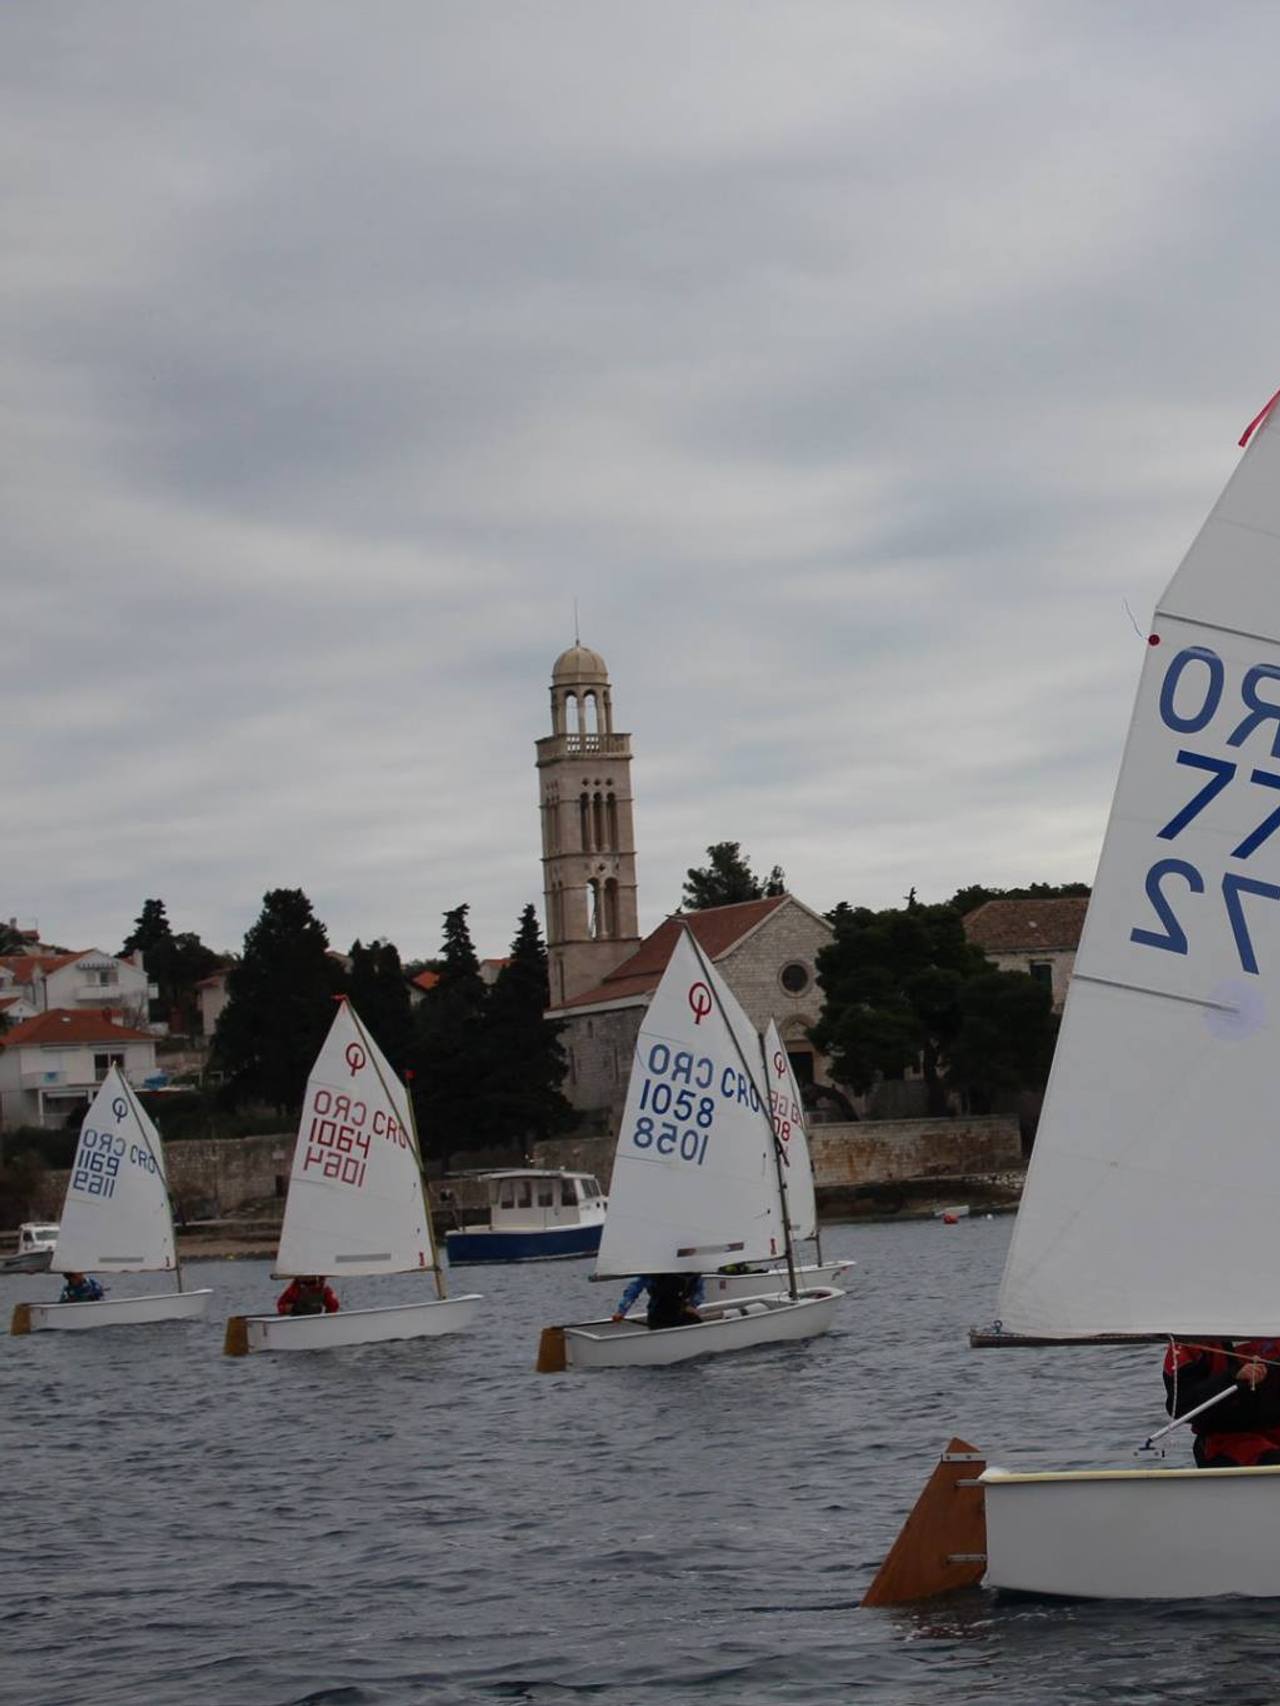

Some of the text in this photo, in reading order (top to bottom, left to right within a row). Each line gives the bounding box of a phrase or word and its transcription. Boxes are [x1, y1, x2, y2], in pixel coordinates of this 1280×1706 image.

[639, 1078, 715, 1128] 1058
[721, 1066, 760, 1113] CRO
[309, 1117, 371, 1159] 1064
[372, 1110, 407, 1149] CRO
[77, 1149, 120, 1177] 1169
